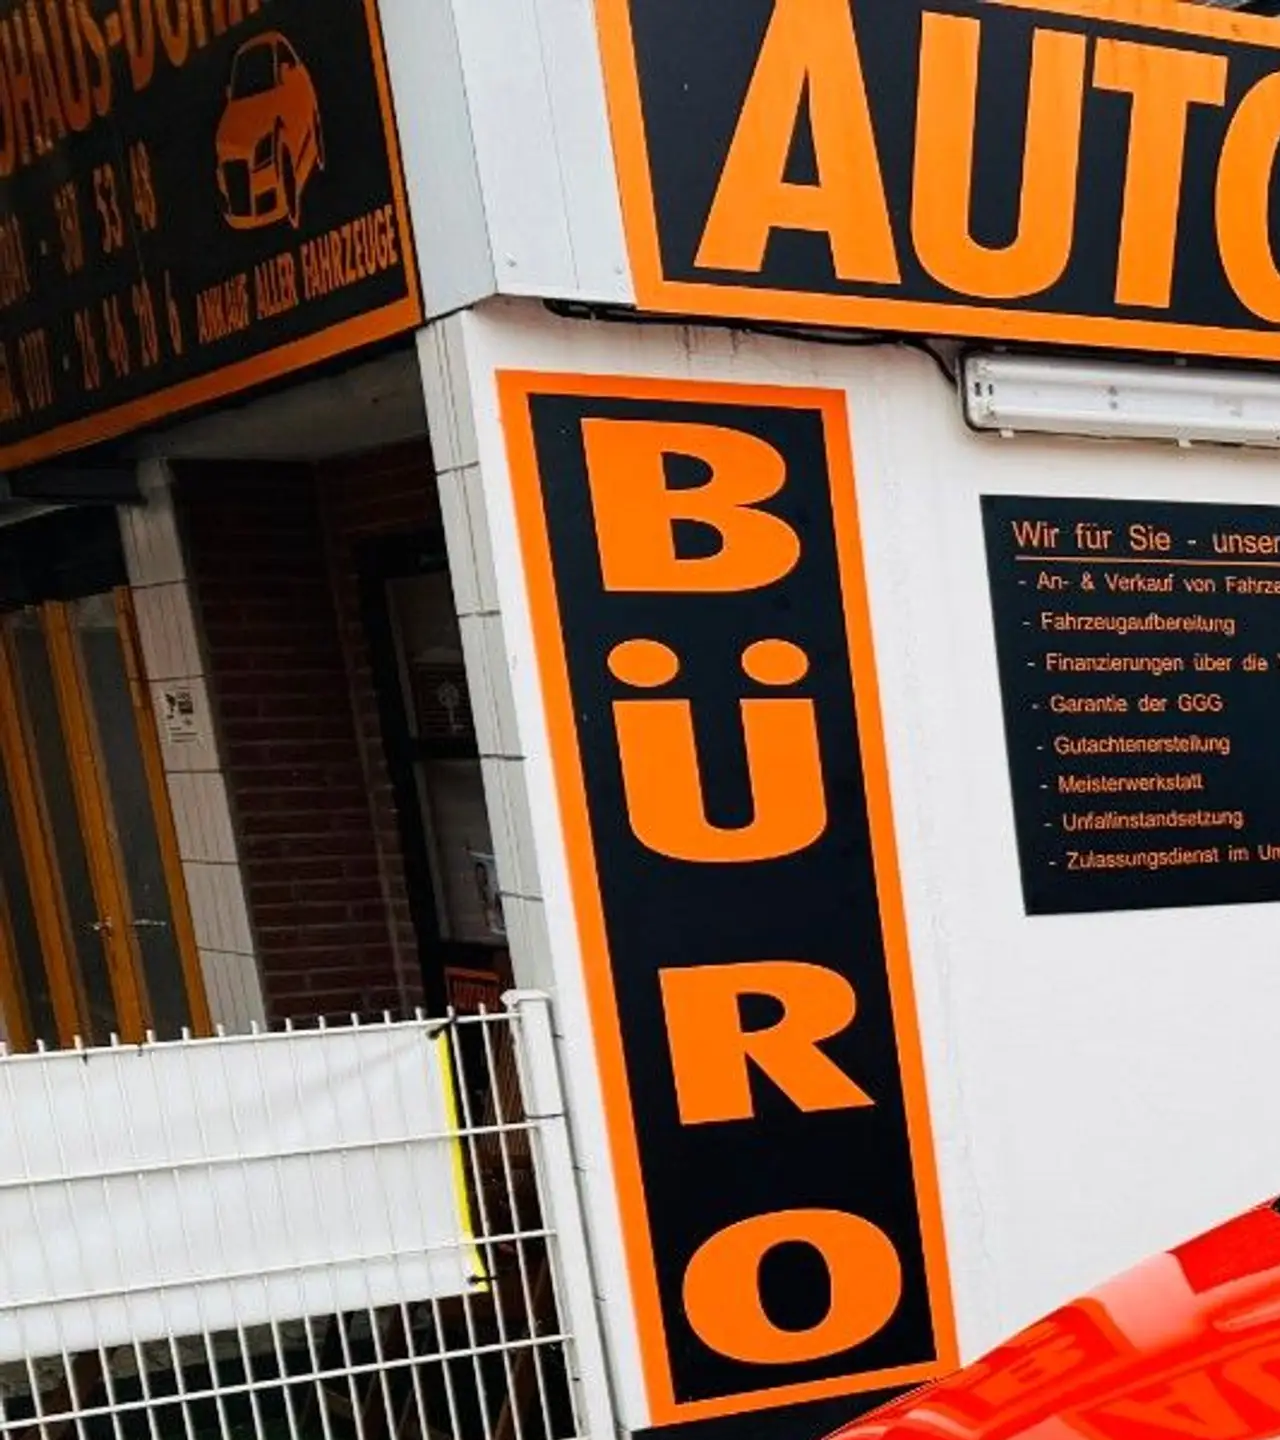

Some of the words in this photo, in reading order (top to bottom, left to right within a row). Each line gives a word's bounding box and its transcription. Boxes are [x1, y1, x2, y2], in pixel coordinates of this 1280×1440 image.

[93, 162, 123, 253] 53
[196, 273, 250, 344] ANKAUF
[254, 252, 299, 320] ALLER
[301, 204, 398, 301] FAHRZEUGE
[1011, 520, 1060, 548] Wir
[1075, 522, 1113, 549] für
[1129, 523, 1171, 551] Sie
[1036, 571, 1069, 590] An-
[1080, 571, 1096, 590] &
[1104, 572, 1175, 592] Verkauf
[1184, 577, 1216, 593] von
[1041, 611, 1236, 636] Fahrzeugaufbereitung
[1046, 653, 1184, 676] Finanzierungen
[1194, 653, 1232, 672] über
[1243, 653, 1268, 671] die
[1050, 694, 1129, 713] Garantie
[1137, 694, 1167, 713] der
[1178, 694, 1223, 713] GGG
[1053, 734, 1231, 755] Gutachtenerstellung
[1058, 773, 1204, 793] Meisterwerkstatt
[1062, 810, 1244, 832] Unfallinstandsetzung
[1066, 847, 1219, 871] Zulassungsdienst
[1228, 845, 1249, 862] im
[581, 417, 902, 1365] BÜRO
